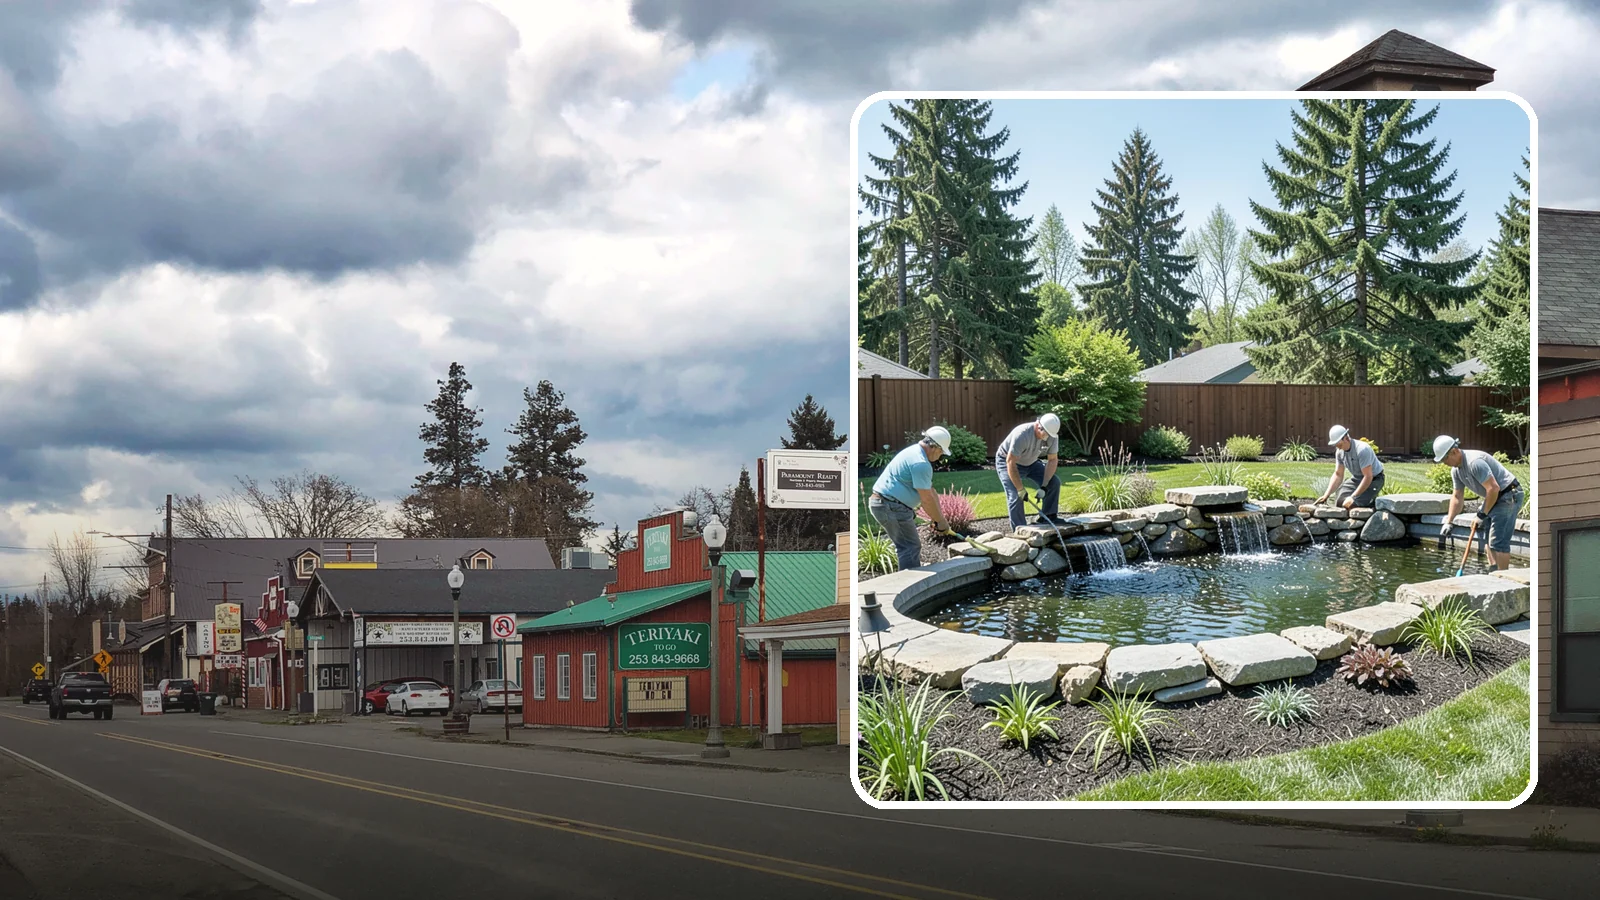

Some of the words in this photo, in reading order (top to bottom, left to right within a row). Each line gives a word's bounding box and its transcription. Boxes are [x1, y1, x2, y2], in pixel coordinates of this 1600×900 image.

[625, 627, 702, 646] TERIYAKI
[629, 654, 648, 664] 253
[651, 654, 700, 664] 843-9668
